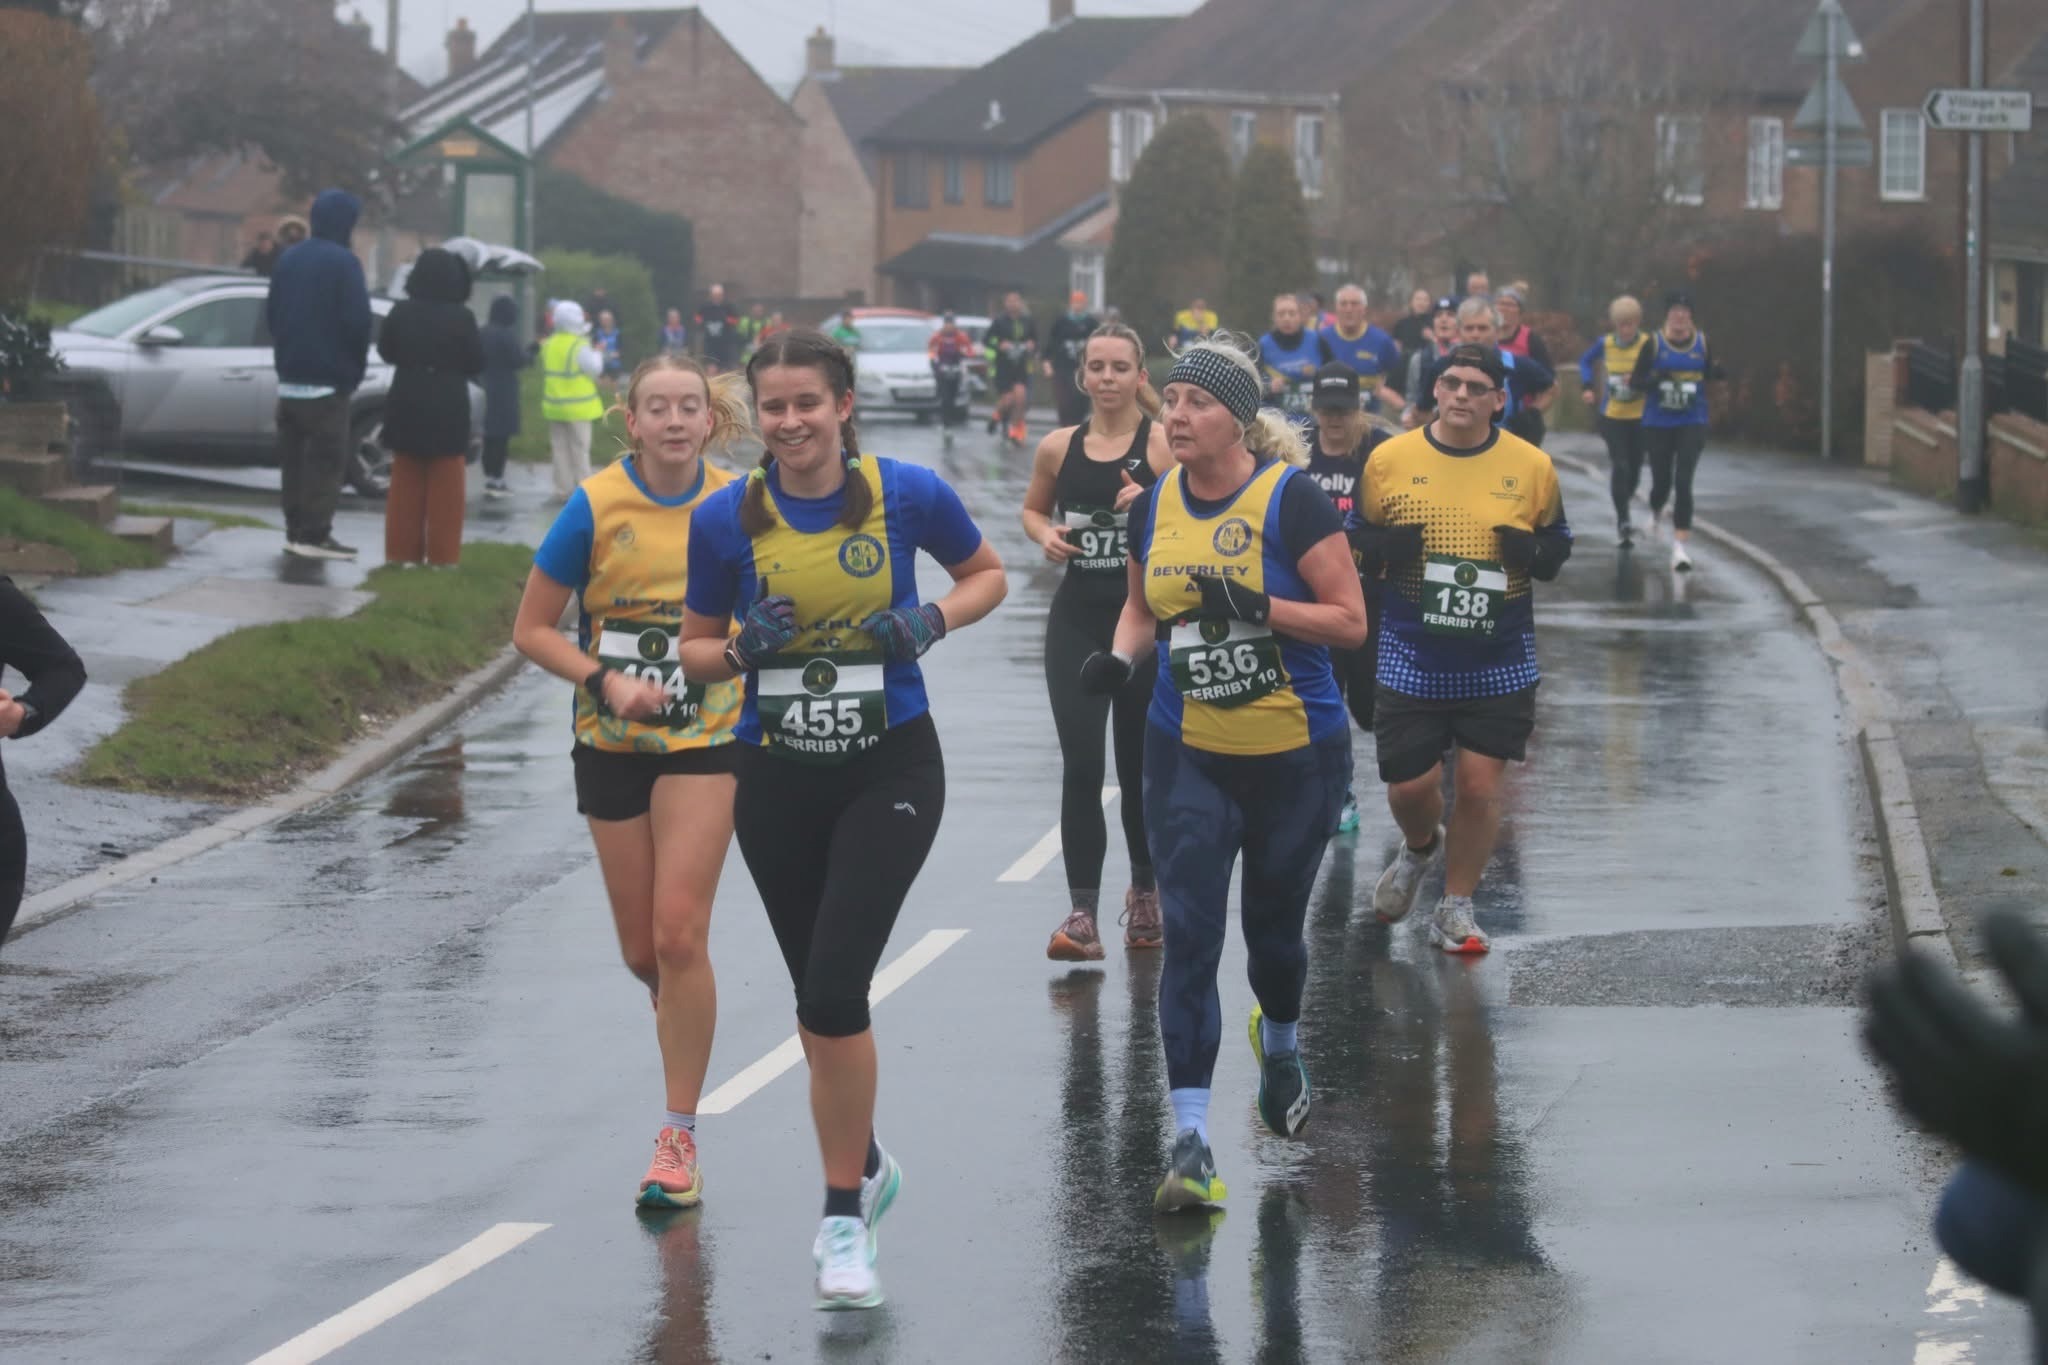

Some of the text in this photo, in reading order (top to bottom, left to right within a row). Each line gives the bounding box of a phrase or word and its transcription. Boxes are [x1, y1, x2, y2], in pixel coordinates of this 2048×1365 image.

[1412, 476, 1429, 485] DC
[1153, 564, 1249, 577] BEVERLEY
[1436, 586, 1490, 618] 138
[1423, 612, 1495, 630] FERRIBY 10
[811, 636, 842, 649] AC
[1188, 643, 1259, 685] 536
[1258, 668, 1277, 684] 10
[780, 698, 863, 737] 455
